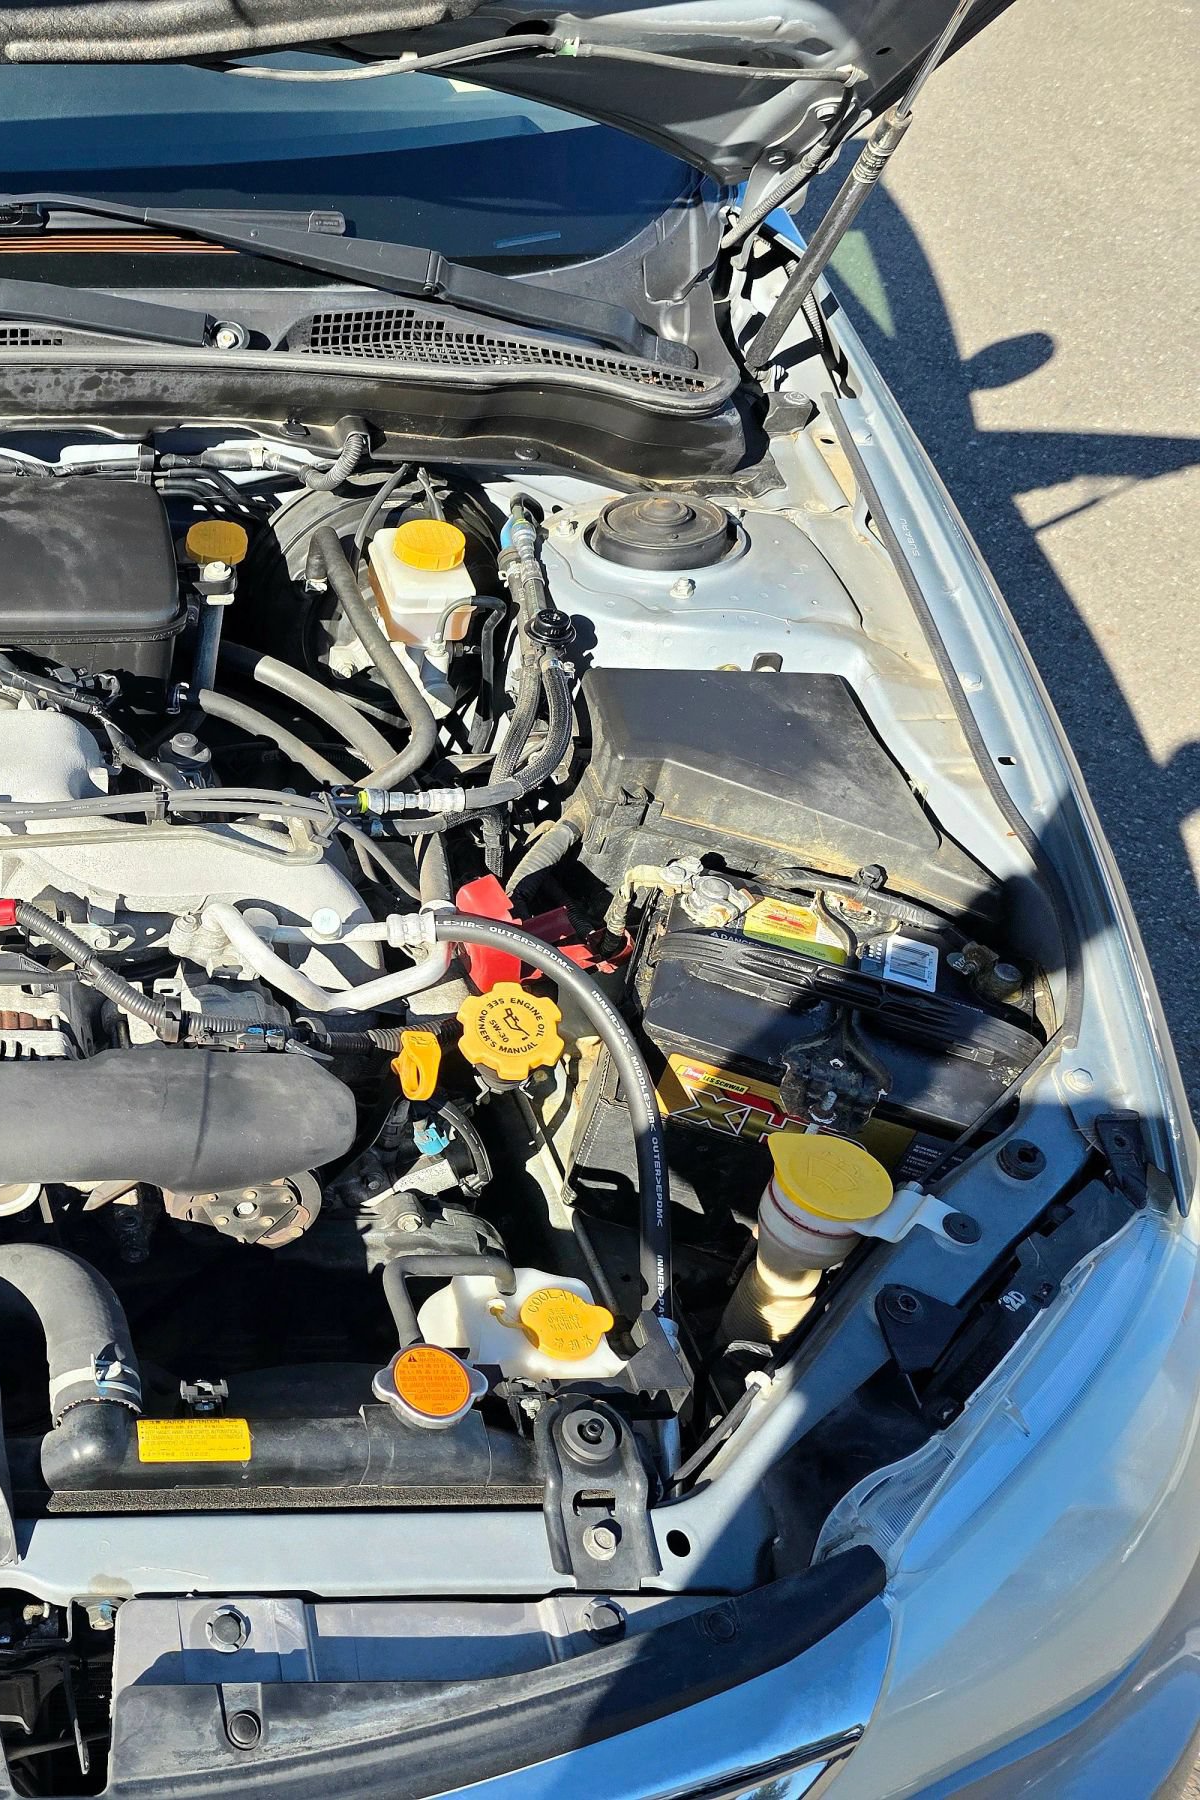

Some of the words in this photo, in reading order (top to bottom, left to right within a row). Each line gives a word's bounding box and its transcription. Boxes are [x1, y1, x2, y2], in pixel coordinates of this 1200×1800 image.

[900, 518, 920, 557] SUBARU
[487, 998, 505, 1009] SEE
[510, 997, 543, 1021] ENGINE
[536, 1023, 545, 1037] OIL
[479, 1009, 497, 1048] OWNER'S
[489, 1019, 510, 1043] 5W-30
[498, 1042, 538, 1054] MANUAL
[656, 1254, 667, 1317] INNER>PA
